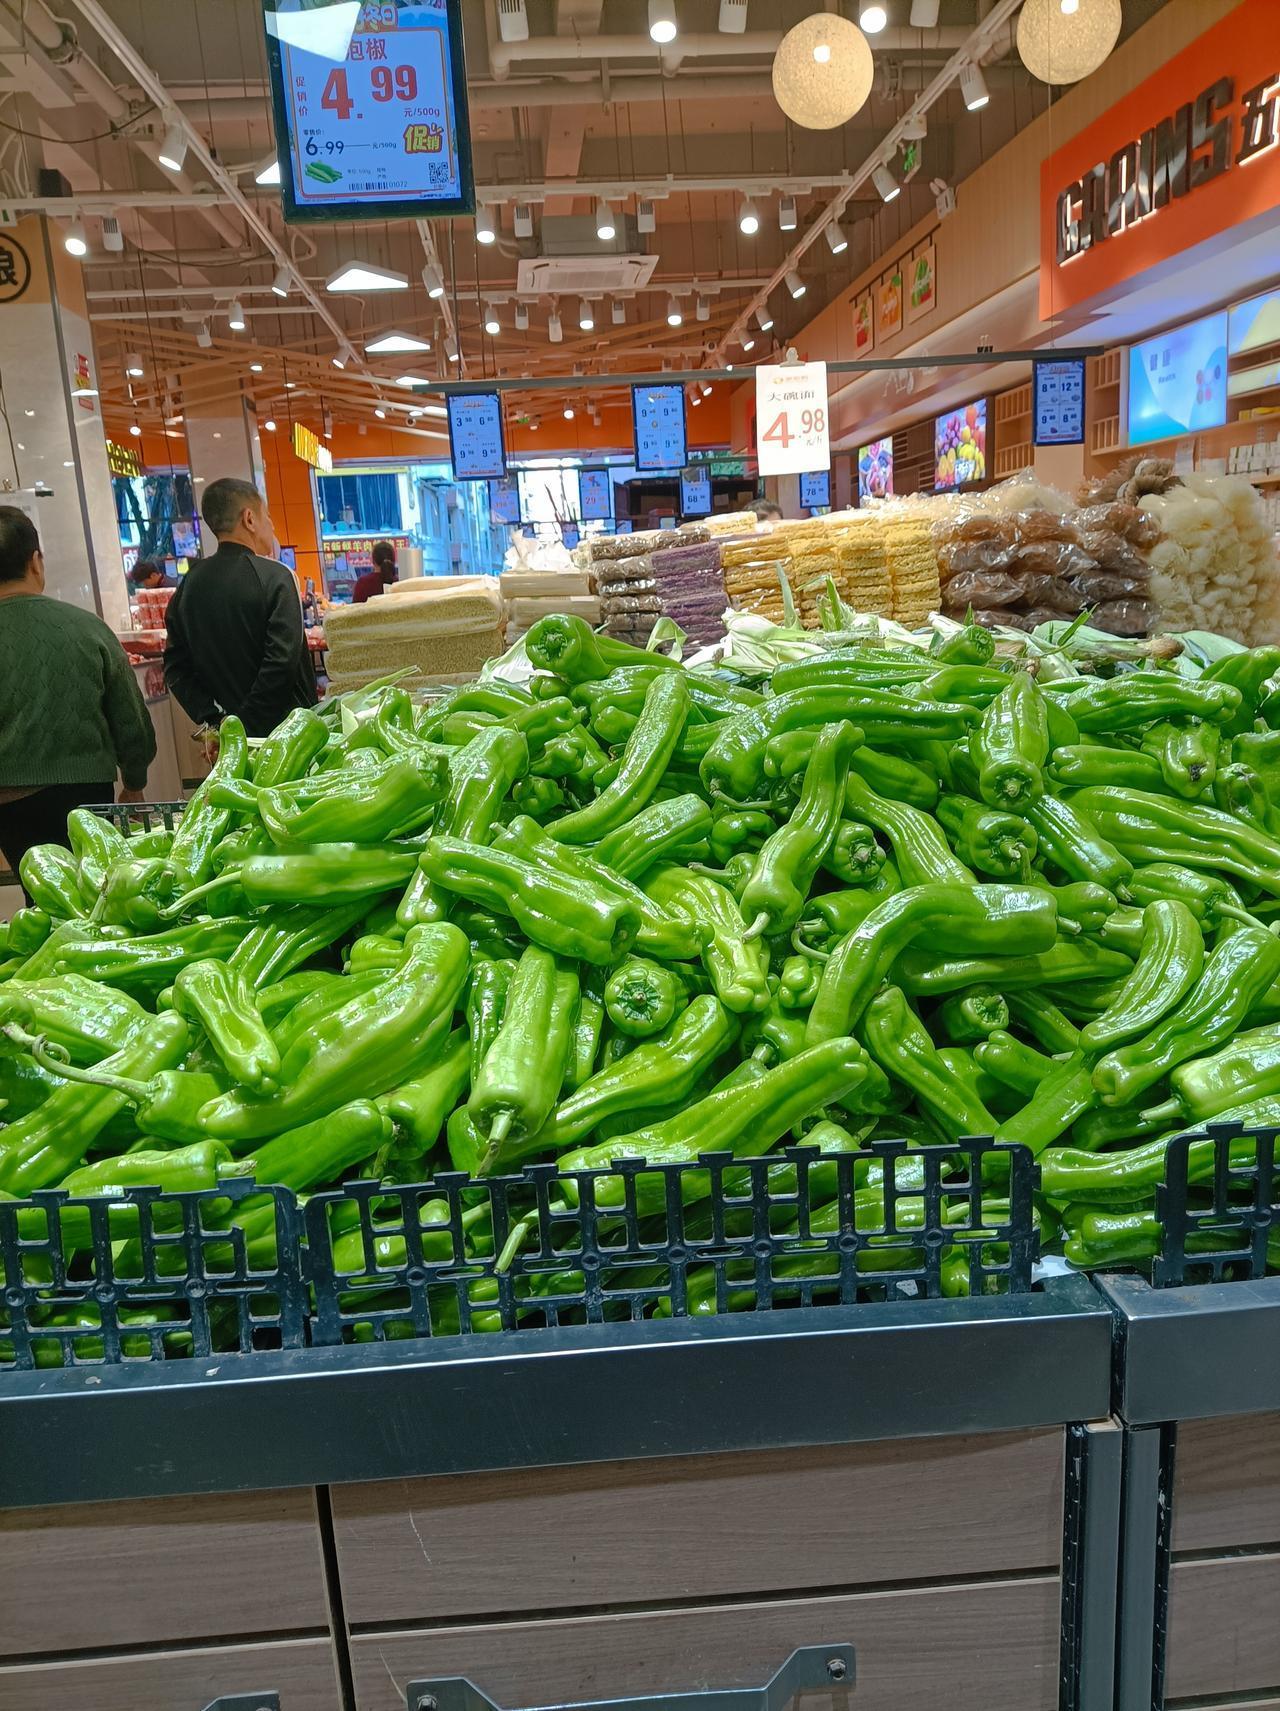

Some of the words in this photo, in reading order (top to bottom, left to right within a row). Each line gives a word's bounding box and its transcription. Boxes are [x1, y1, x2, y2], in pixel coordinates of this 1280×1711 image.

[295, 75, 308, 117] 促销价
[403, 106, 440, 118] 元/500g
[306, 137, 345, 157] 6.99
[403, 123, 443, 154] 促销
